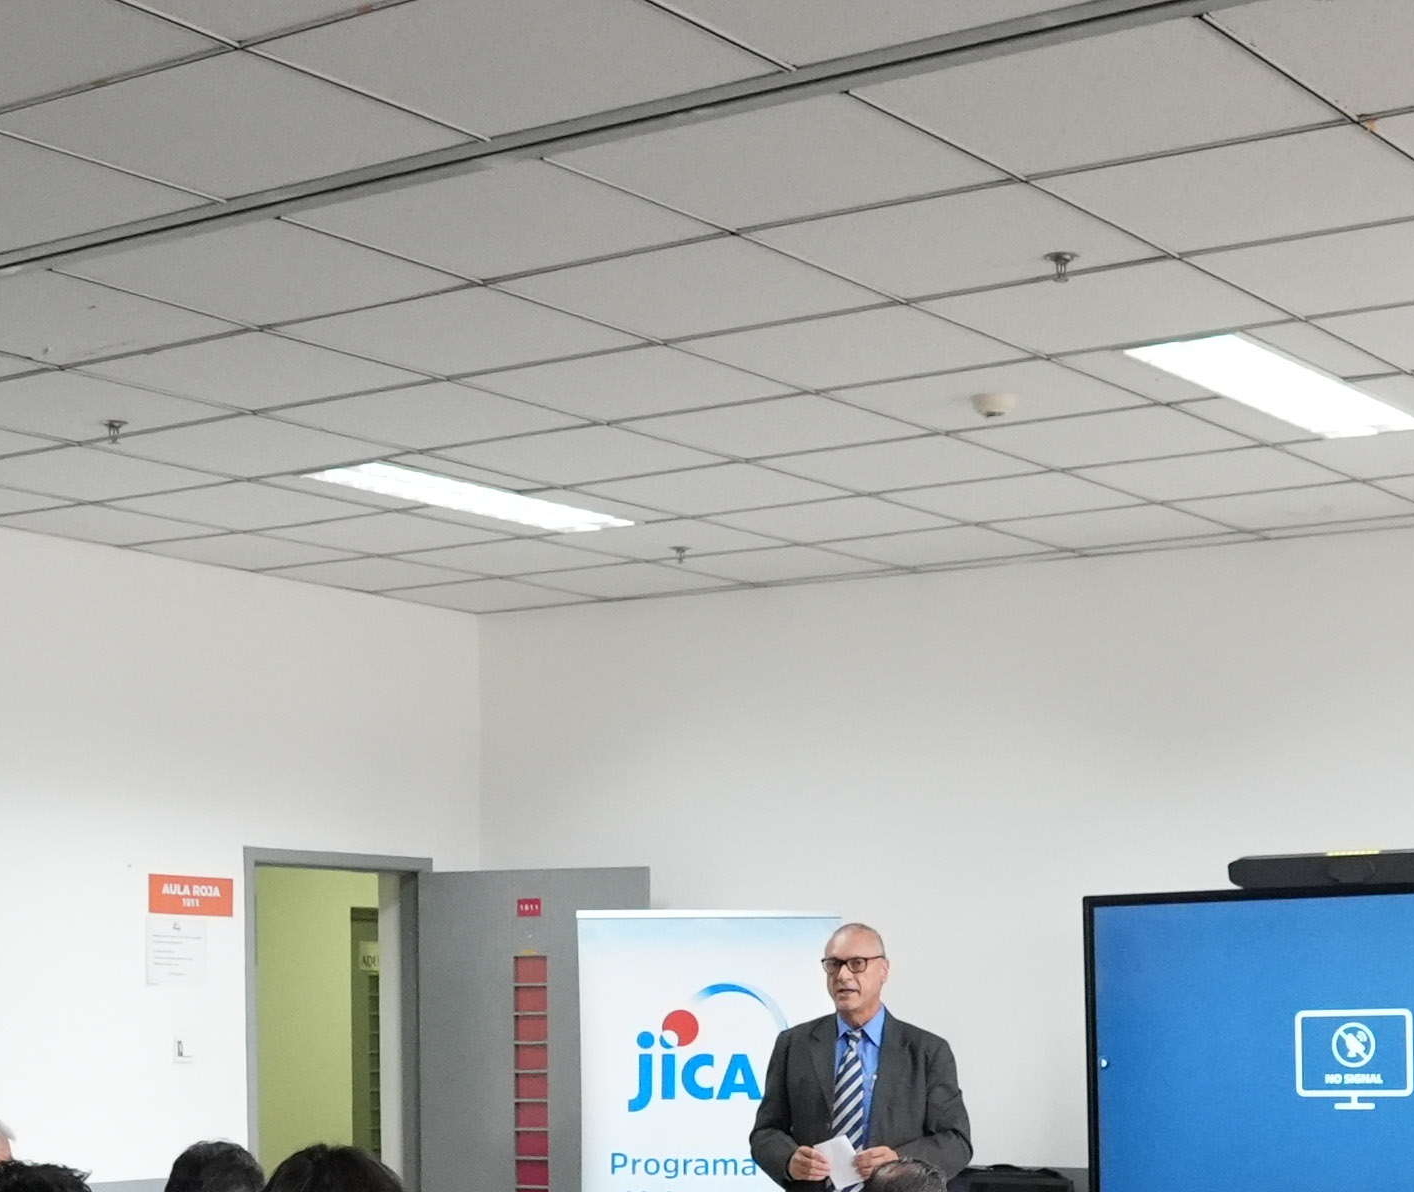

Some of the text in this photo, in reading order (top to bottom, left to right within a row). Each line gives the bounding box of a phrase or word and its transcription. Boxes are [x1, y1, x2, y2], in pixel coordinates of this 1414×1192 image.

[162, 883, 221, 898] AULA ROJA
[1325, 1073, 1384, 1085] NO SIGNAL
[611, 1152, 757, 1179] Programa
